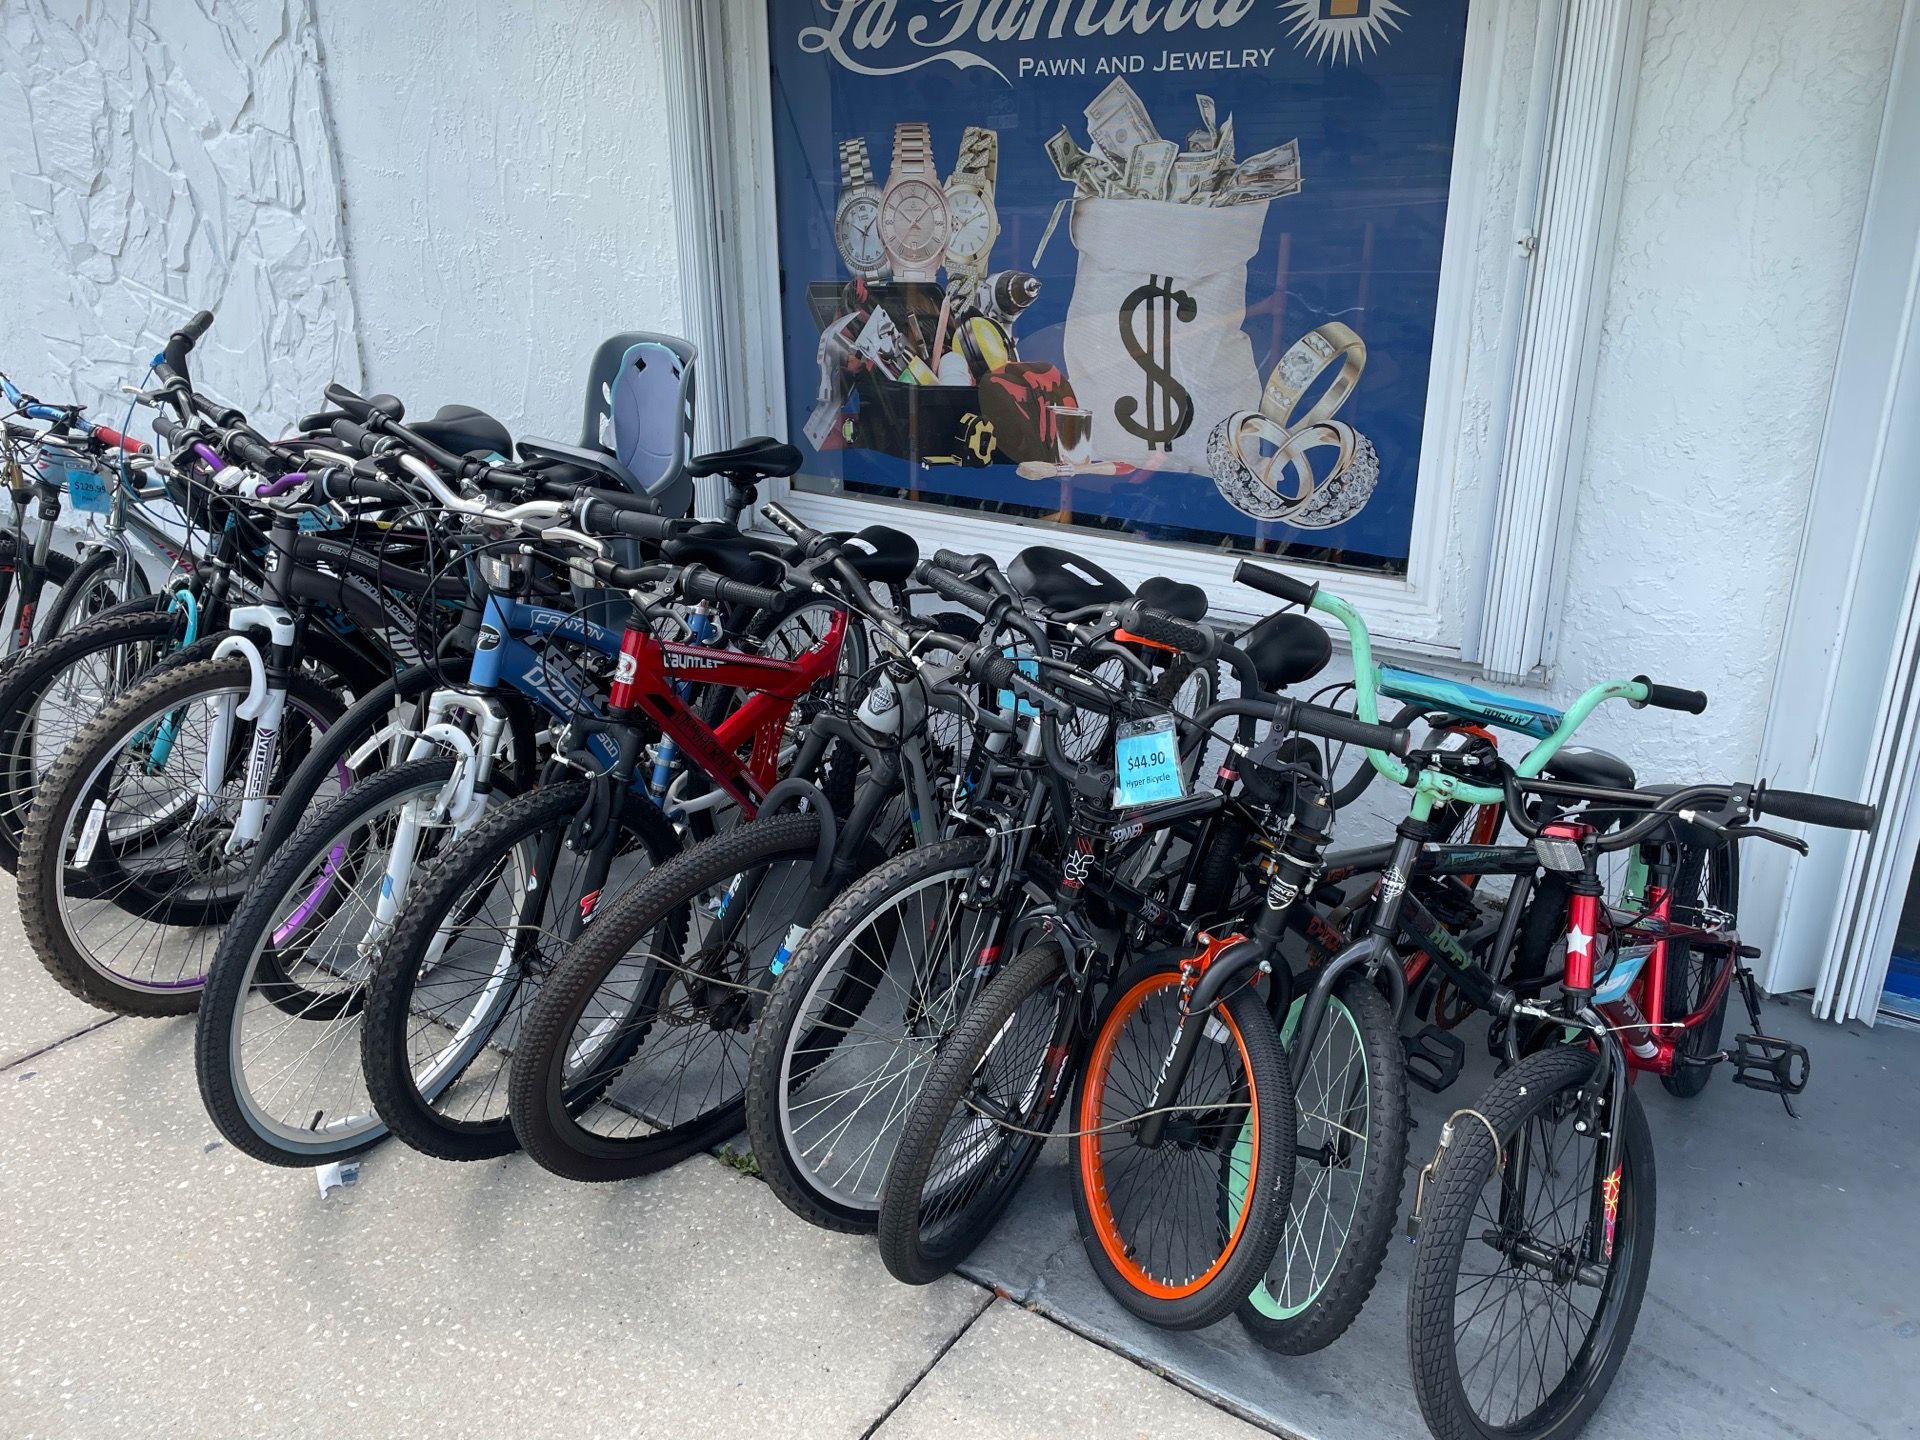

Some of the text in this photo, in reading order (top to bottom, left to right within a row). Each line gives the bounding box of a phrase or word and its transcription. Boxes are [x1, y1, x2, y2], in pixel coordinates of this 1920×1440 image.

[1019, 48, 1276, 78] PAWN AND JEWELRY
[534, 613, 605, 642] CANYON
[1127, 751, 1166, 772] $44.90
[1126, 773, 1171, 789] Hyper Bicycle
